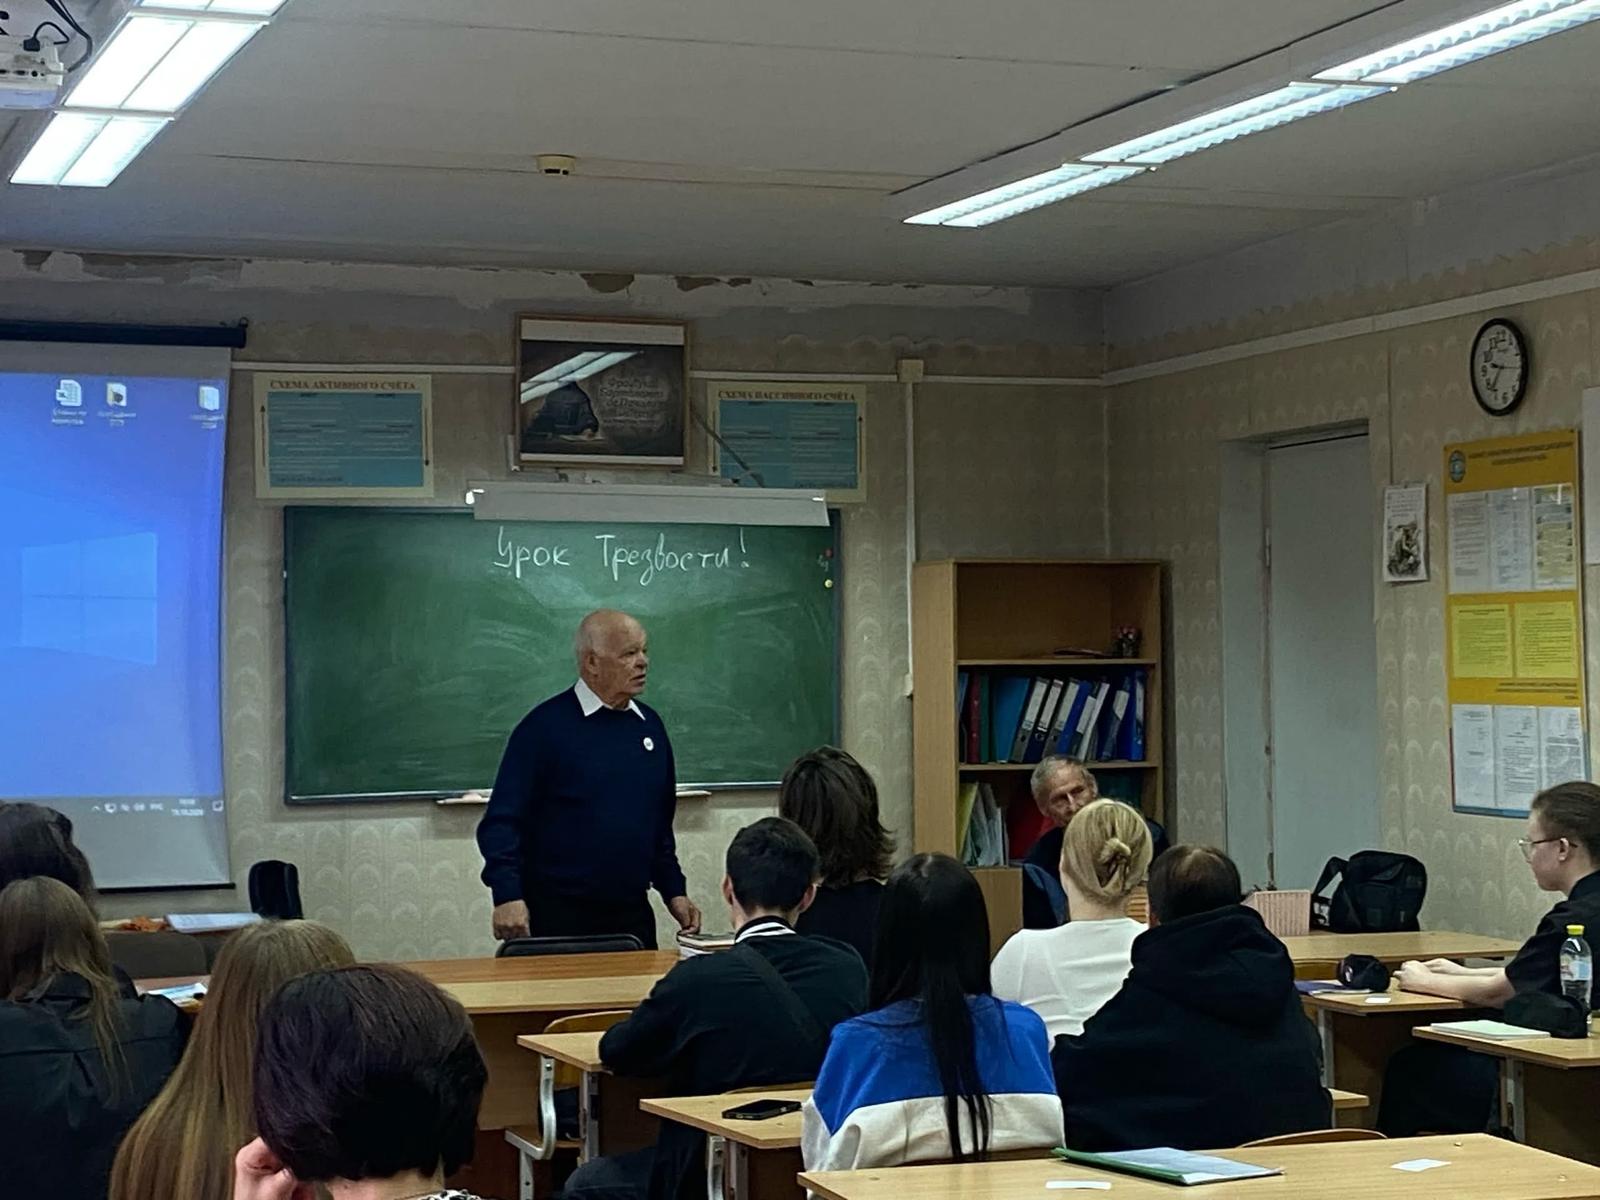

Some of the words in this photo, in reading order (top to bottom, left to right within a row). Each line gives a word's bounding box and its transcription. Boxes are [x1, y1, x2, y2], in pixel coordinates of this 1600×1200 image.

[270, 379, 309, 390] СХЕМА
[312, 379, 379, 390] АКТИВНОГО
[718, 390, 753, 400] СХЕМА
[755, 390, 822, 400] ПАССИВНОГО
[493, 526, 570, 578] Урок
[595, 527, 751, 585] Трезвости!
